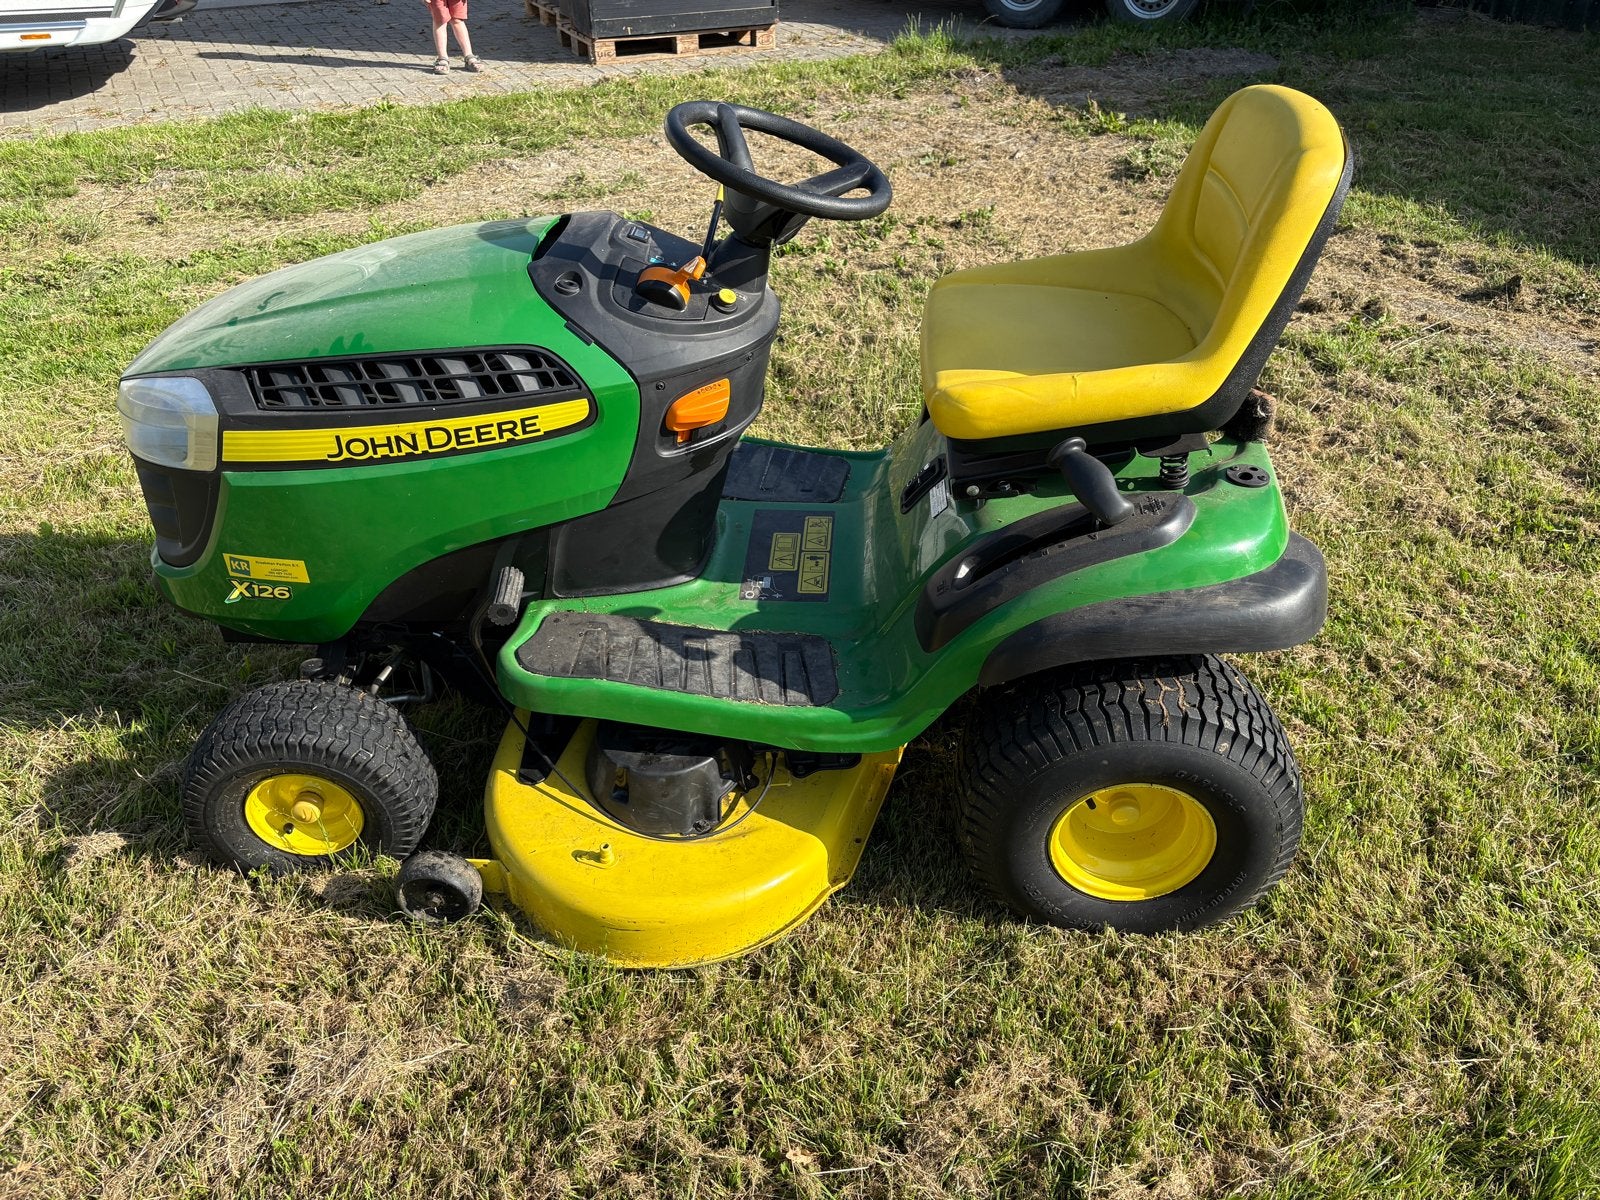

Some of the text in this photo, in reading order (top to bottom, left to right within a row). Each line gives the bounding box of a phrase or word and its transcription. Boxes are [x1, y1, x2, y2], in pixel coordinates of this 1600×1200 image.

[326, 415, 541, 459] JOHN DEERE
[230, 560, 250, 571] KR
[225, 580, 291, 602] X126
